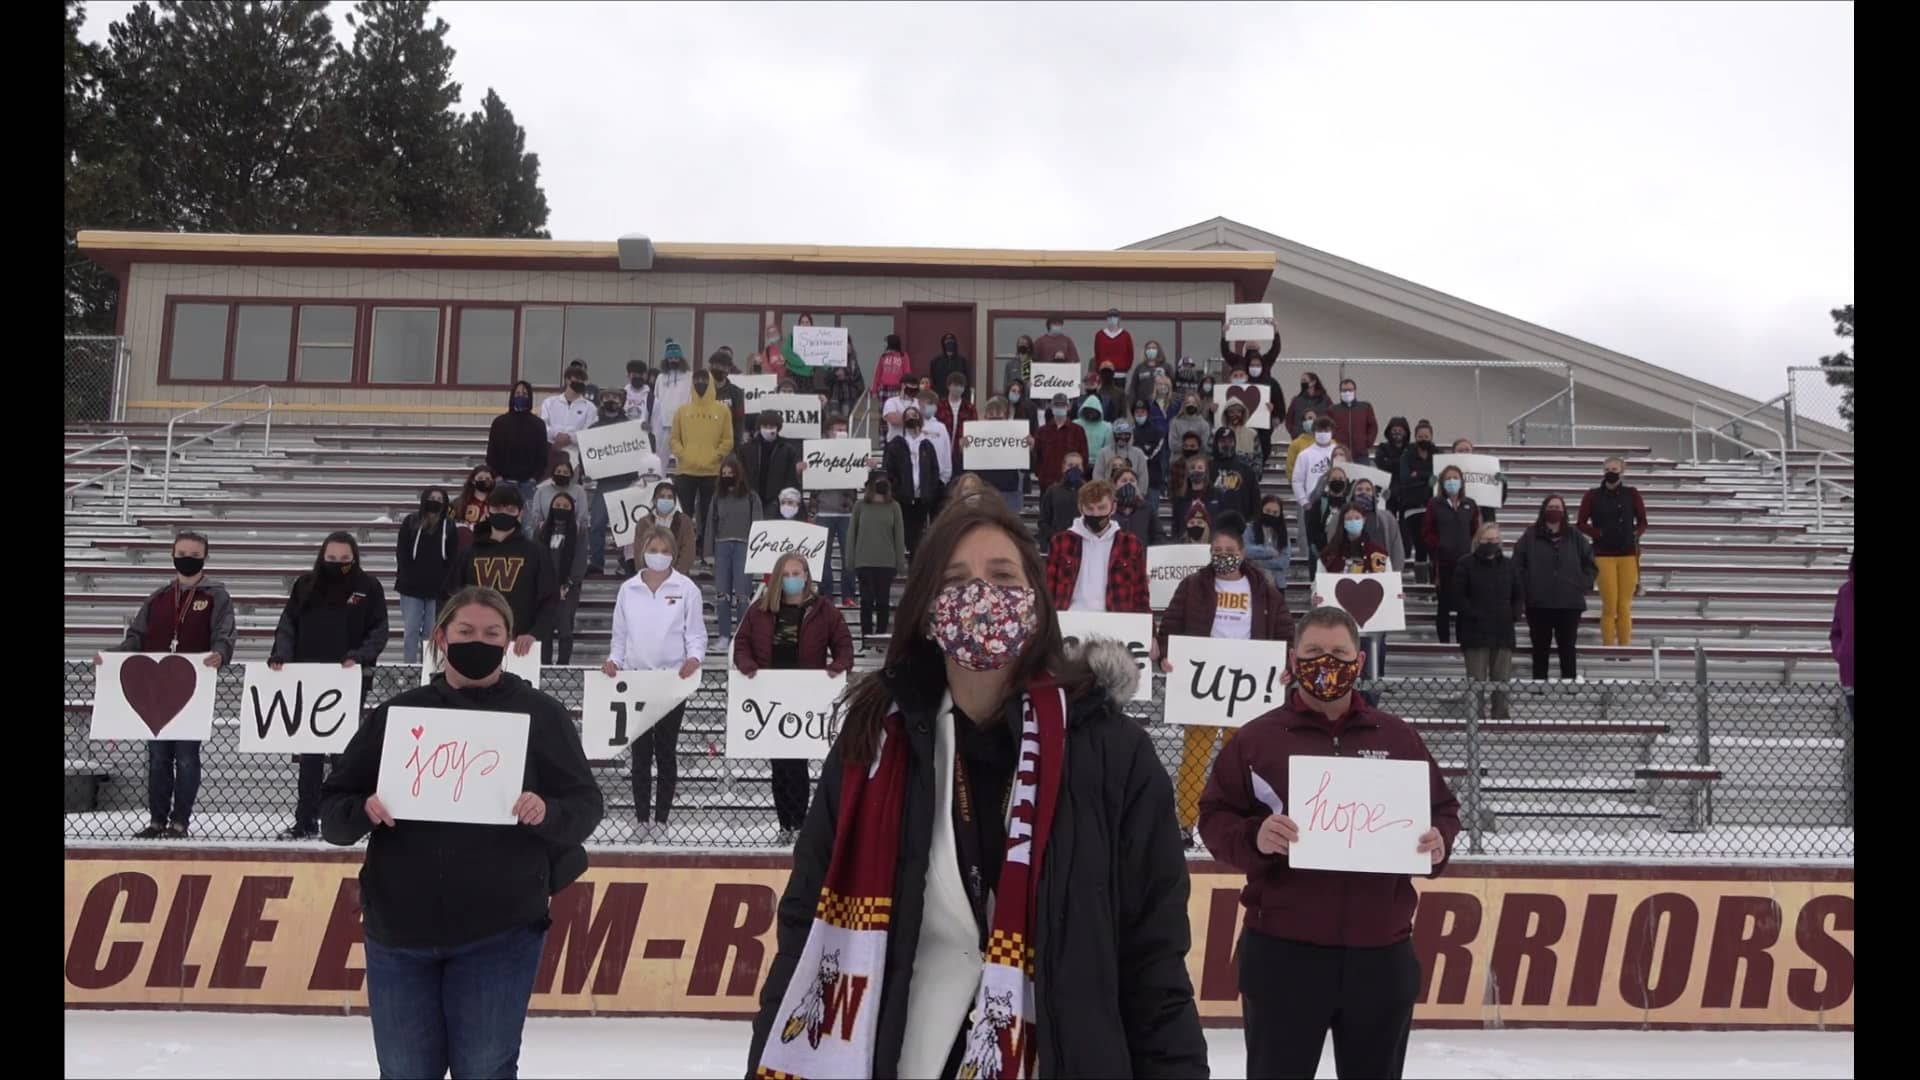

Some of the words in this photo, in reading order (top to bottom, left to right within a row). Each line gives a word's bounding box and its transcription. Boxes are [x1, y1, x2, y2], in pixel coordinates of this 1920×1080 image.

[1033, 374, 1074, 388] Believe
[777, 409, 819, 424] REAM
[586, 440, 646, 460] Optimistic
[966, 435, 1028, 449] Persevere
[807, 450, 869, 473] Hopeful
[613, 499, 657, 534] Jo
[749, 530, 826, 559] Grateful
[474, 557, 525, 592] W
[1216, 592, 1249, 610] RIBE
[250, 680, 346, 740] We
[405, 725, 500, 802] joy
[1304, 770, 1413, 849] hope
[64, 871, 294, 990] CLE
[1200, 888, 1854, 1011] RRIORS
